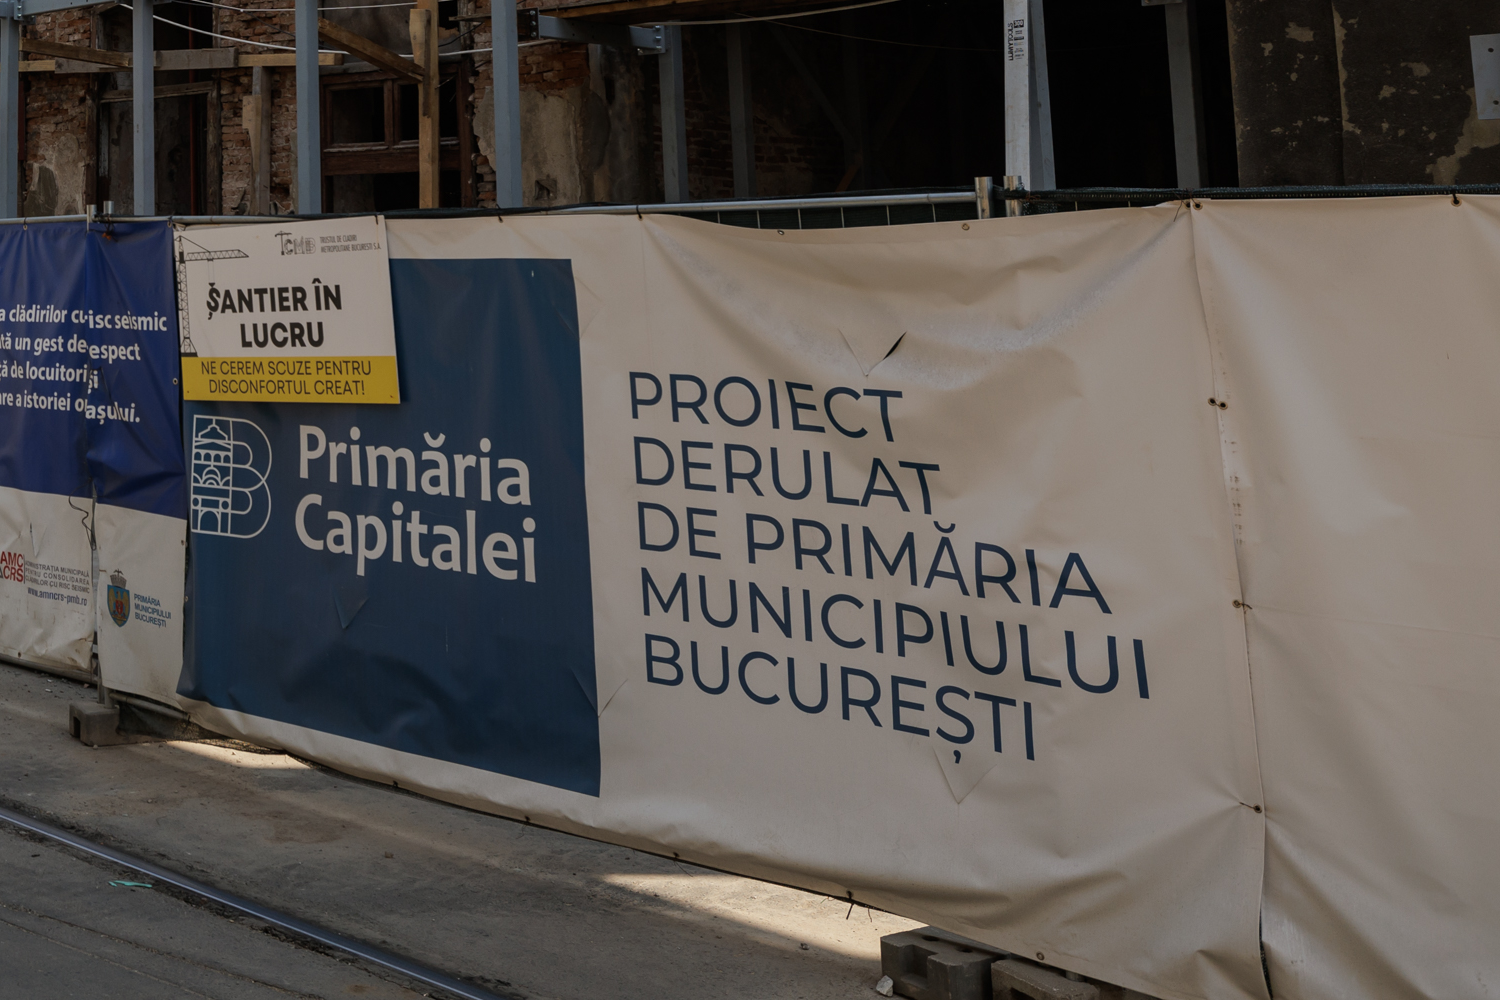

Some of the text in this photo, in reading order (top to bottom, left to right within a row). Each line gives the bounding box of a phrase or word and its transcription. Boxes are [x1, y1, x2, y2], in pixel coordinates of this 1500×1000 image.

[206, 277, 342, 320] ȘANTIER ÎN
[9, 304, 67, 323] clădirilor
[84, 309, 112, 329] isc
[115, 310, 167, 331] seismic
[240, 321, 325, 348] LUCRU
[15, 336, 30, 350] un
[34, 336, 64, 355] gest
[67, 334, 87, 353] de
[86, 343, 141, 364] espect
[11, 360, 24, 379] de
[26, 361, 87, 382] locuitori
[201, 360, 372, 376] NE CEREM SCUZE PENTRU
[16, 394, 22, 406] a
[23, 388, 70, 411] istoriei
[209, 379, 365, 396] DISCONFORTUL CREAT!
[629, 371, 903, 442] PROIECT
[299, 424, 532, 507] Primăria
[633, 435, 941, 515] DERULAT
[295, 494, 537, 583] Capitalei
[0, 550, 23, 567] AMC
[637, 501, 1113, 614] DE PRIMĂRIA
[3, 565, 23, 583] CRS
[25, 567, 90, 586] PENTRU CONSOLIDAREA
[49, 580, 58, 588] CU
[59, 582, 70, 590] RISC
[134, 593, 161, 607] PRIMĂRIA
[134, 602, 171, 619] MUNICIPIULUI
[134, 611, 167, 628] BUCUREȘTI
[640, 567, 1150, 700] MUNICIPIULUI
[644, 633, 1035, 764] BUCUREȘTI
